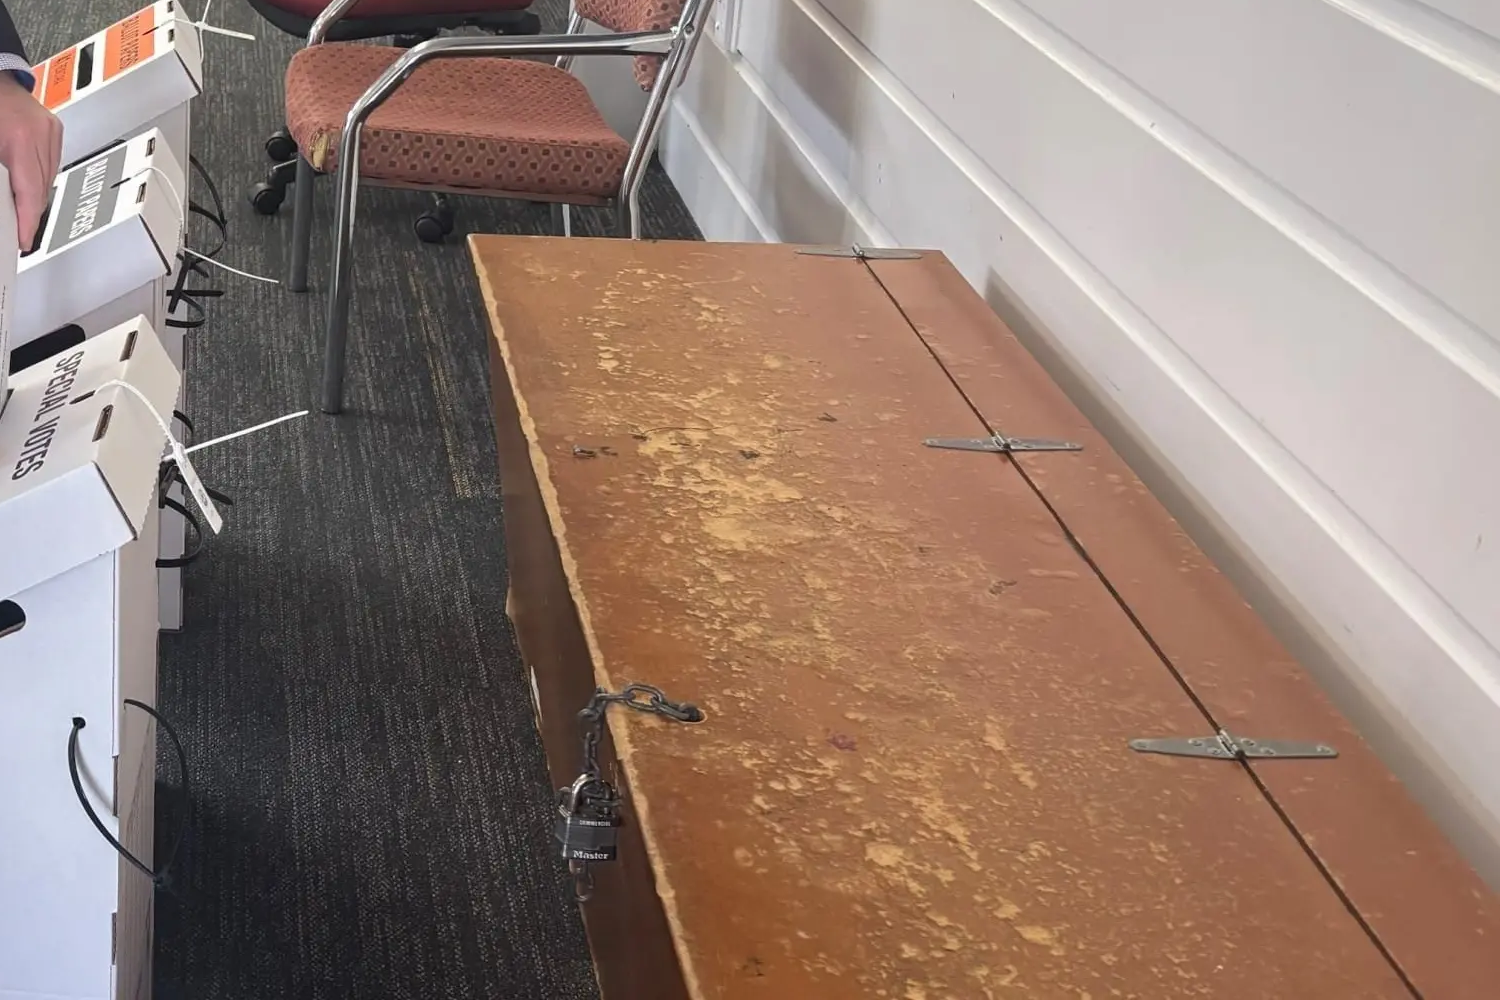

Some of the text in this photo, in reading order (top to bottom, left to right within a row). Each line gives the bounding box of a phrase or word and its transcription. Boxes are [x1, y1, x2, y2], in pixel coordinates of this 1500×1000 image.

[68, 158, 108, 239] BALLOT PAPERS
[11, 350, 85, 481] SPECIAL VOTES
[573, 850, 609, 860] Master
